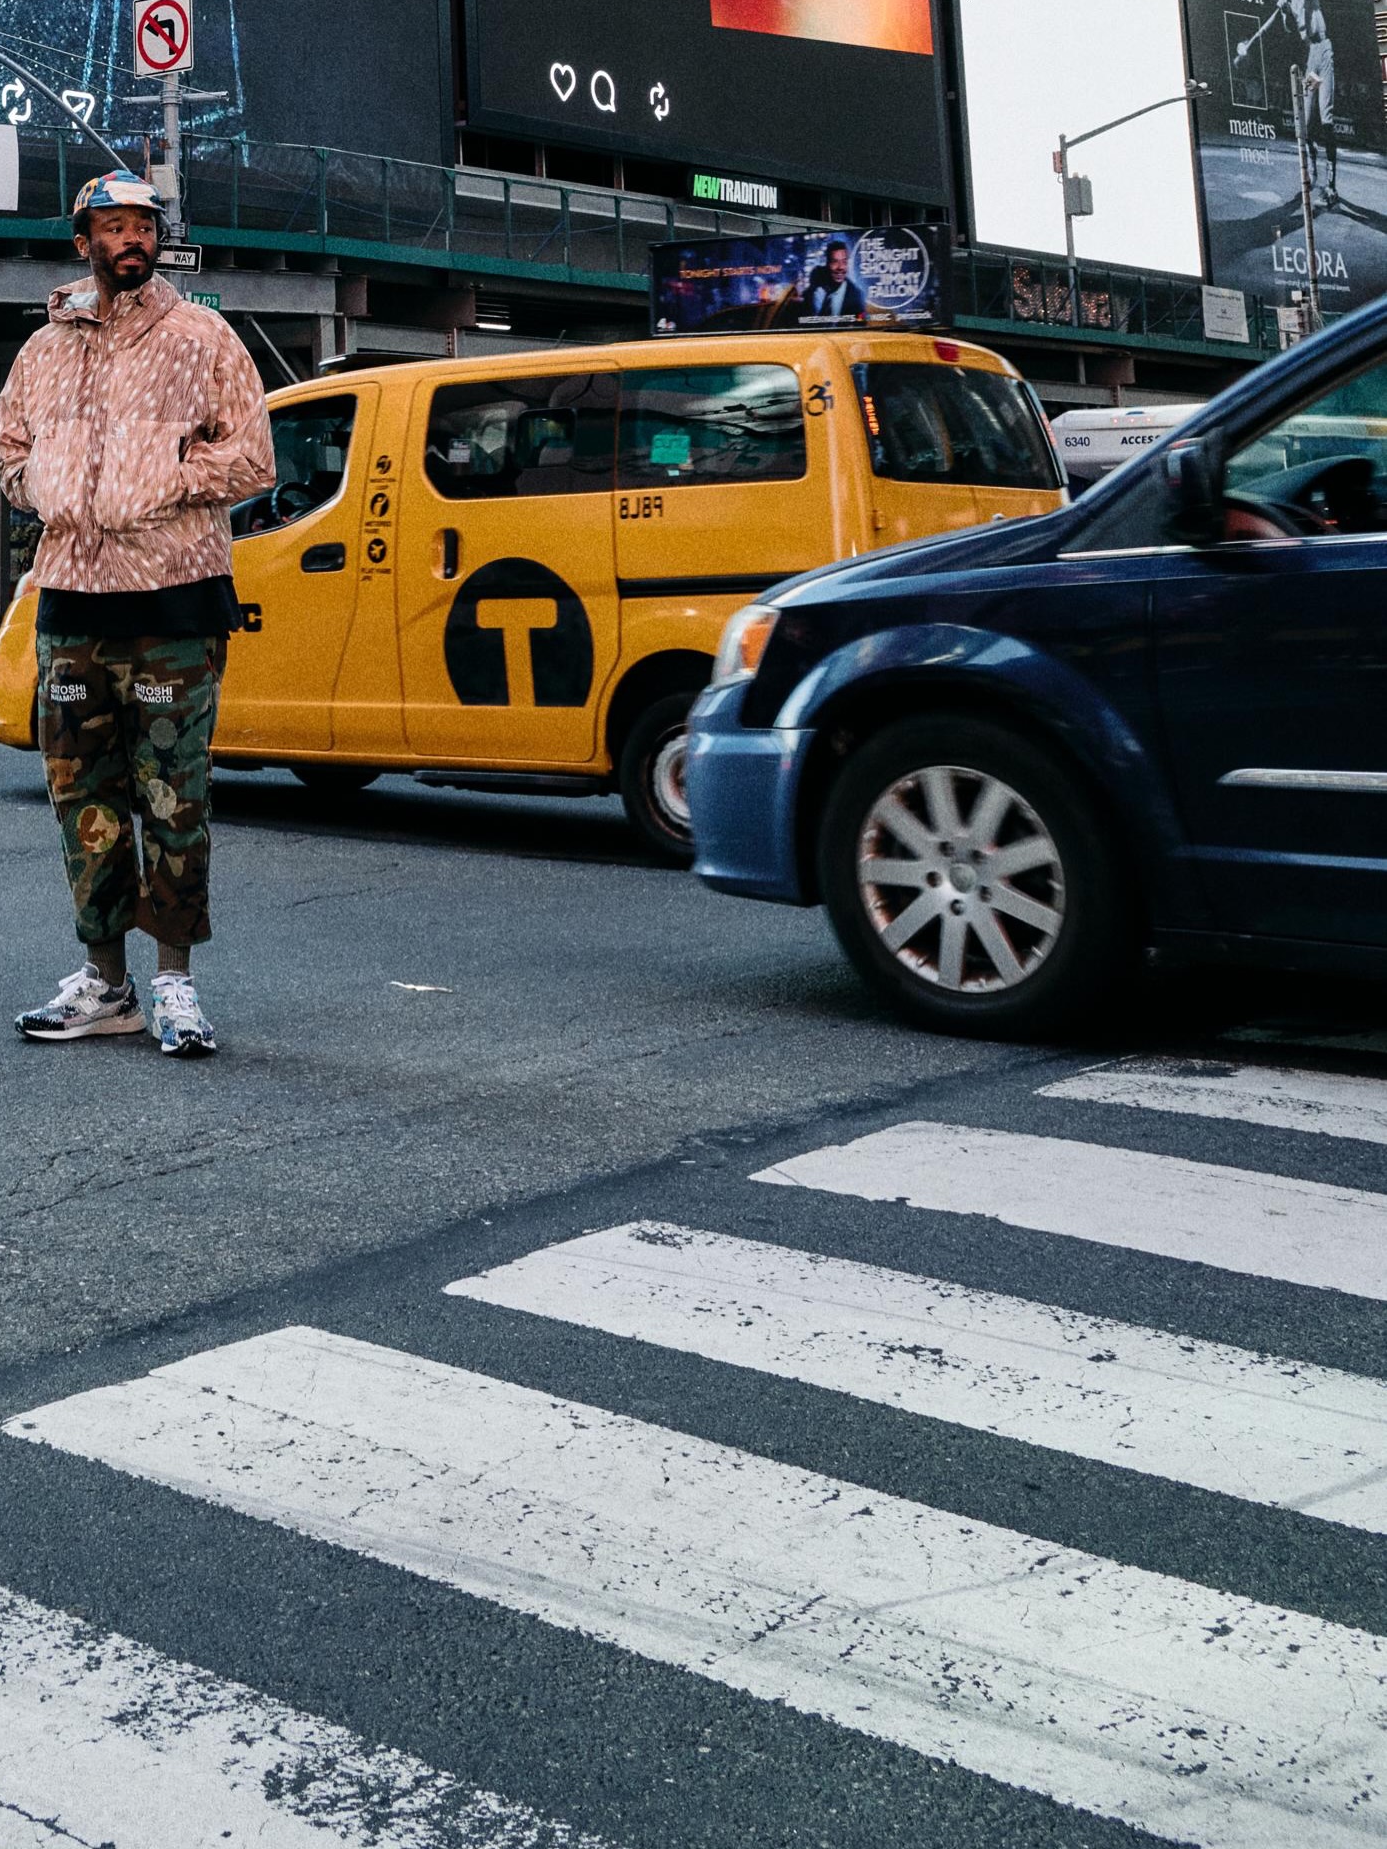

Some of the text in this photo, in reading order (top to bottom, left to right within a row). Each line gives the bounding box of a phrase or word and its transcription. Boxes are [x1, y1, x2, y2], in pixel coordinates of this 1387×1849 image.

[1229, 119, 1276, 140] matters
[859, 237, 885, 250] THE
[174, 252, 193, 264] WAY
[859, 248, 920, 262] TONIGHT
[860, 261, 902, 274] SHOW
[876, 272, 921, 286] JIMMY
[868, 284, 918, 298] FALLON
[1065, 436, 1091, 447] 6340
